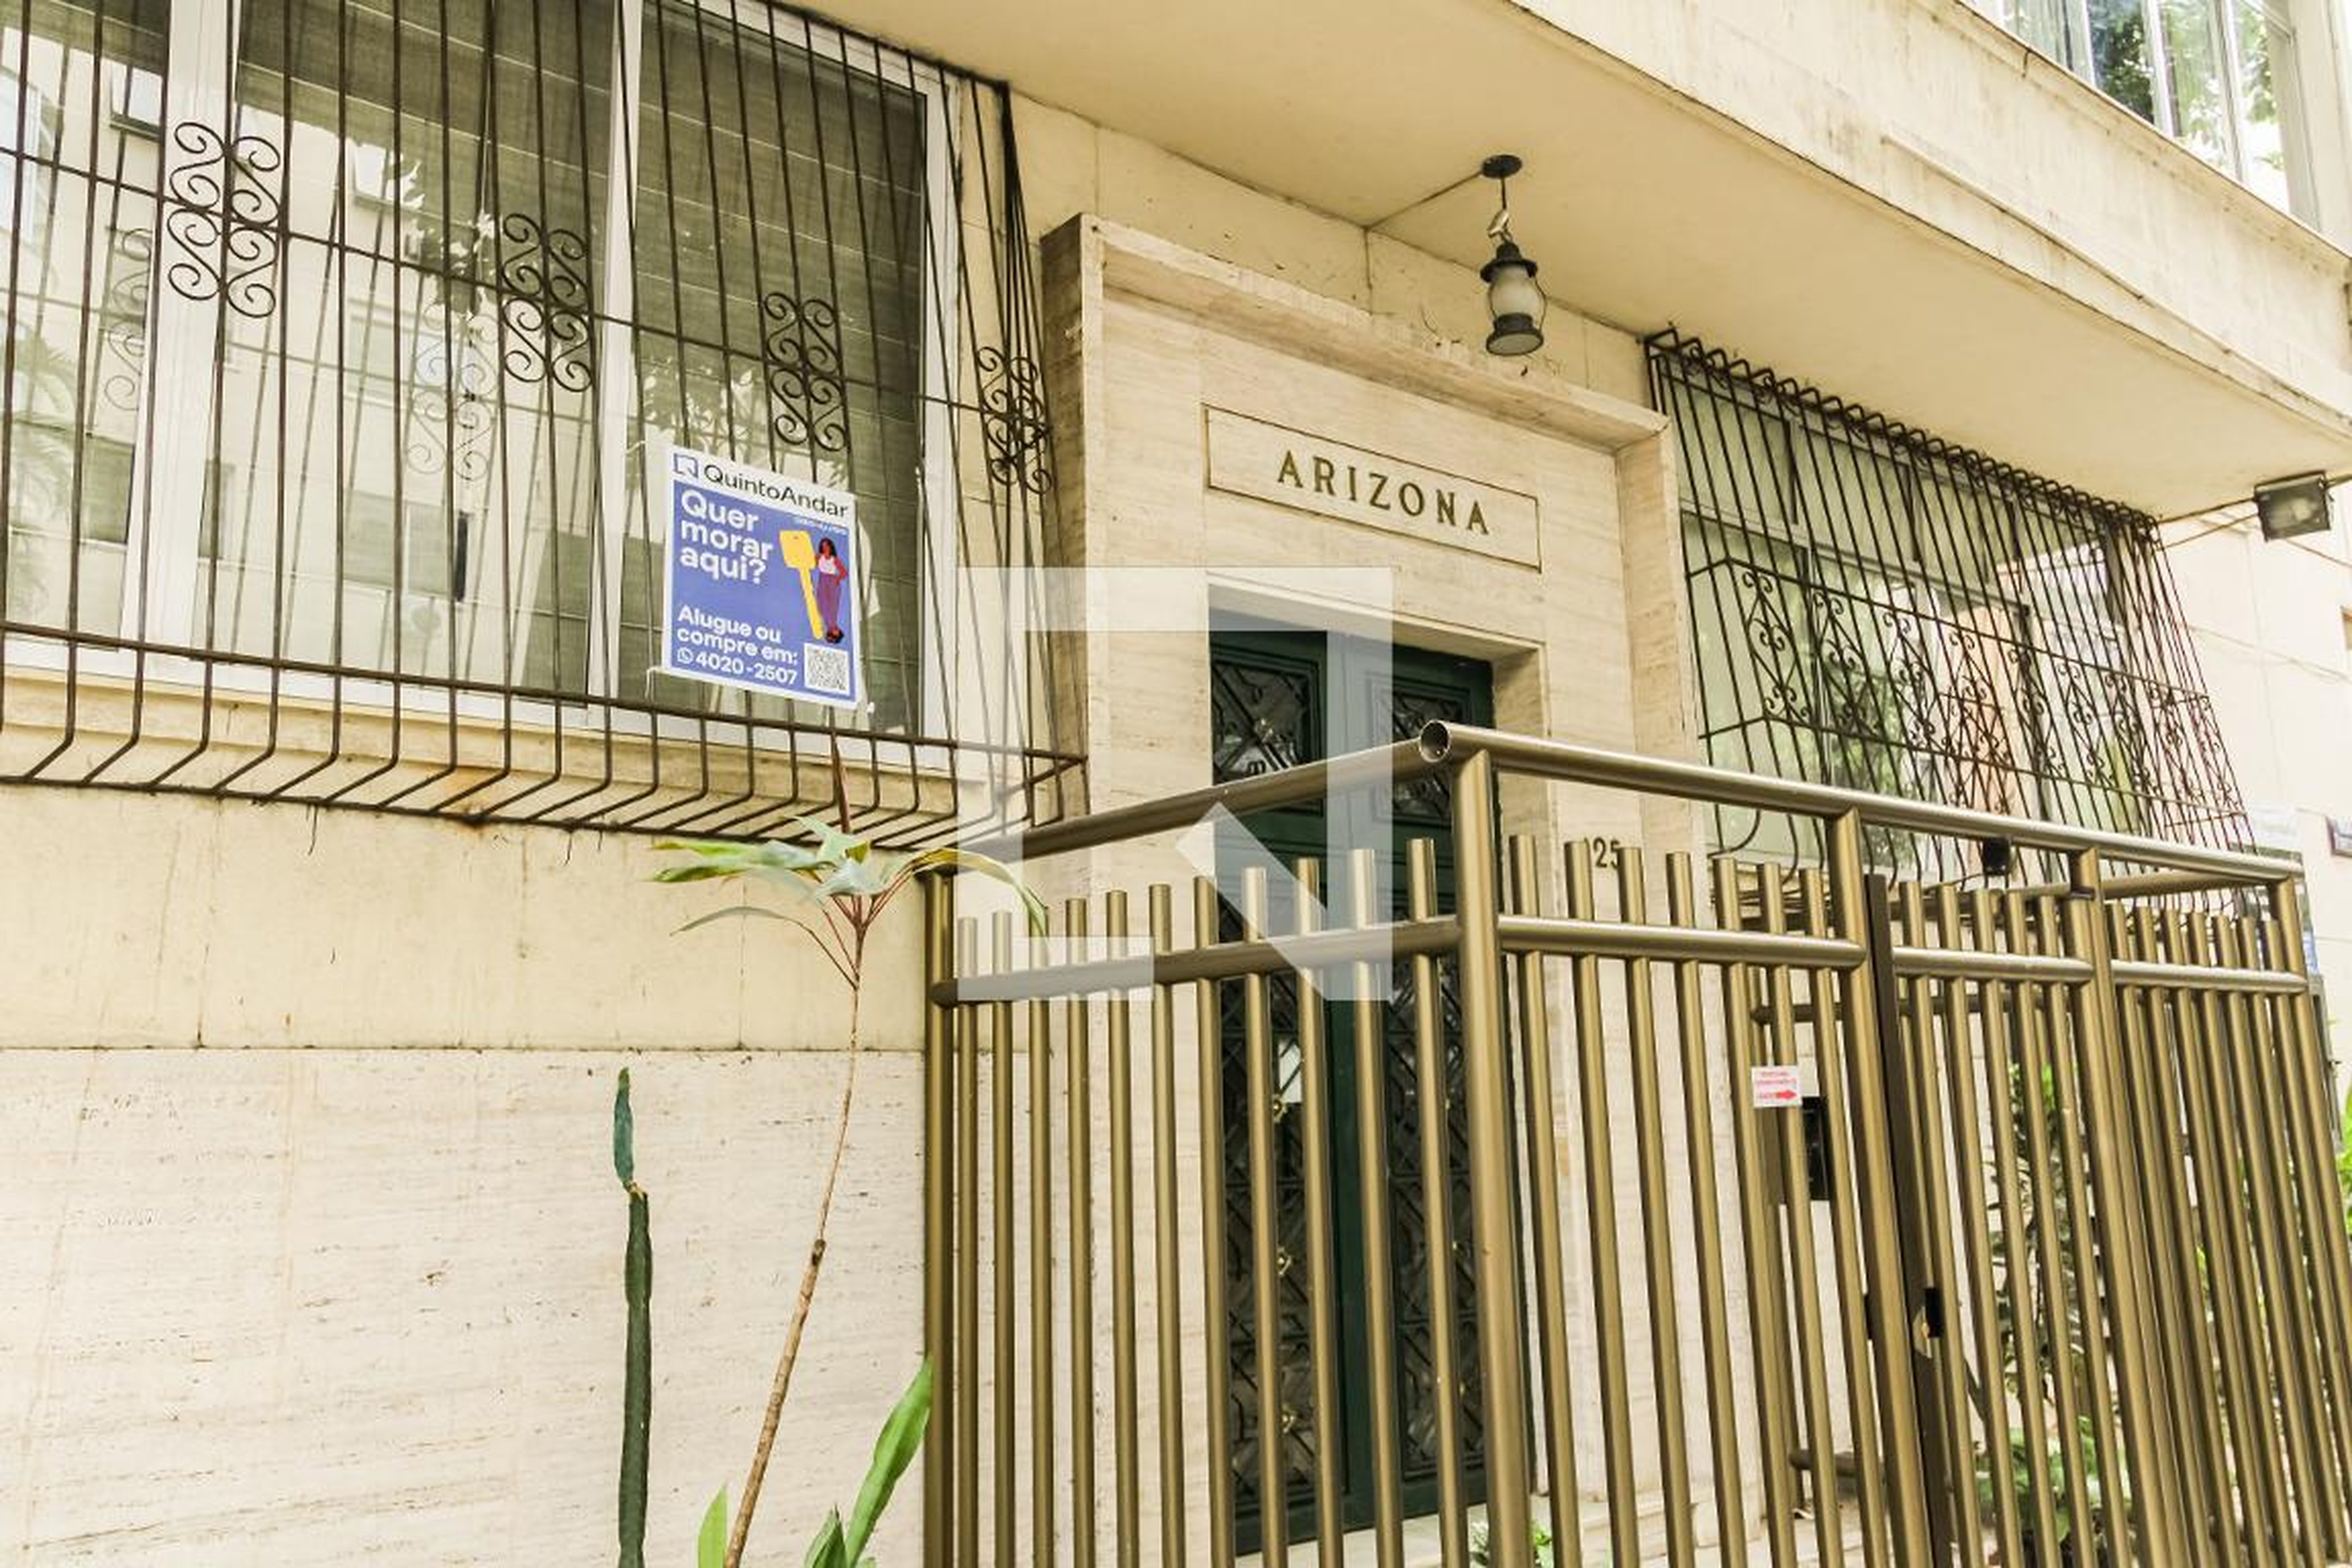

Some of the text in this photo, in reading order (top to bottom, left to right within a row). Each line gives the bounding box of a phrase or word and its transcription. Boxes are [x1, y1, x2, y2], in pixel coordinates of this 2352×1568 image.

[681, 489, 758, 532] Quer
[704, 464, 848, 518] QuintoAndar
[1278, 450, 1489, 535] ARIZONA
[681, 520, 773, 560] morar
[680, 547, 766, 584] aqui?
[677, 605, 781, 643] Alugue ou
[677, 628, 797, 665] compre em:
